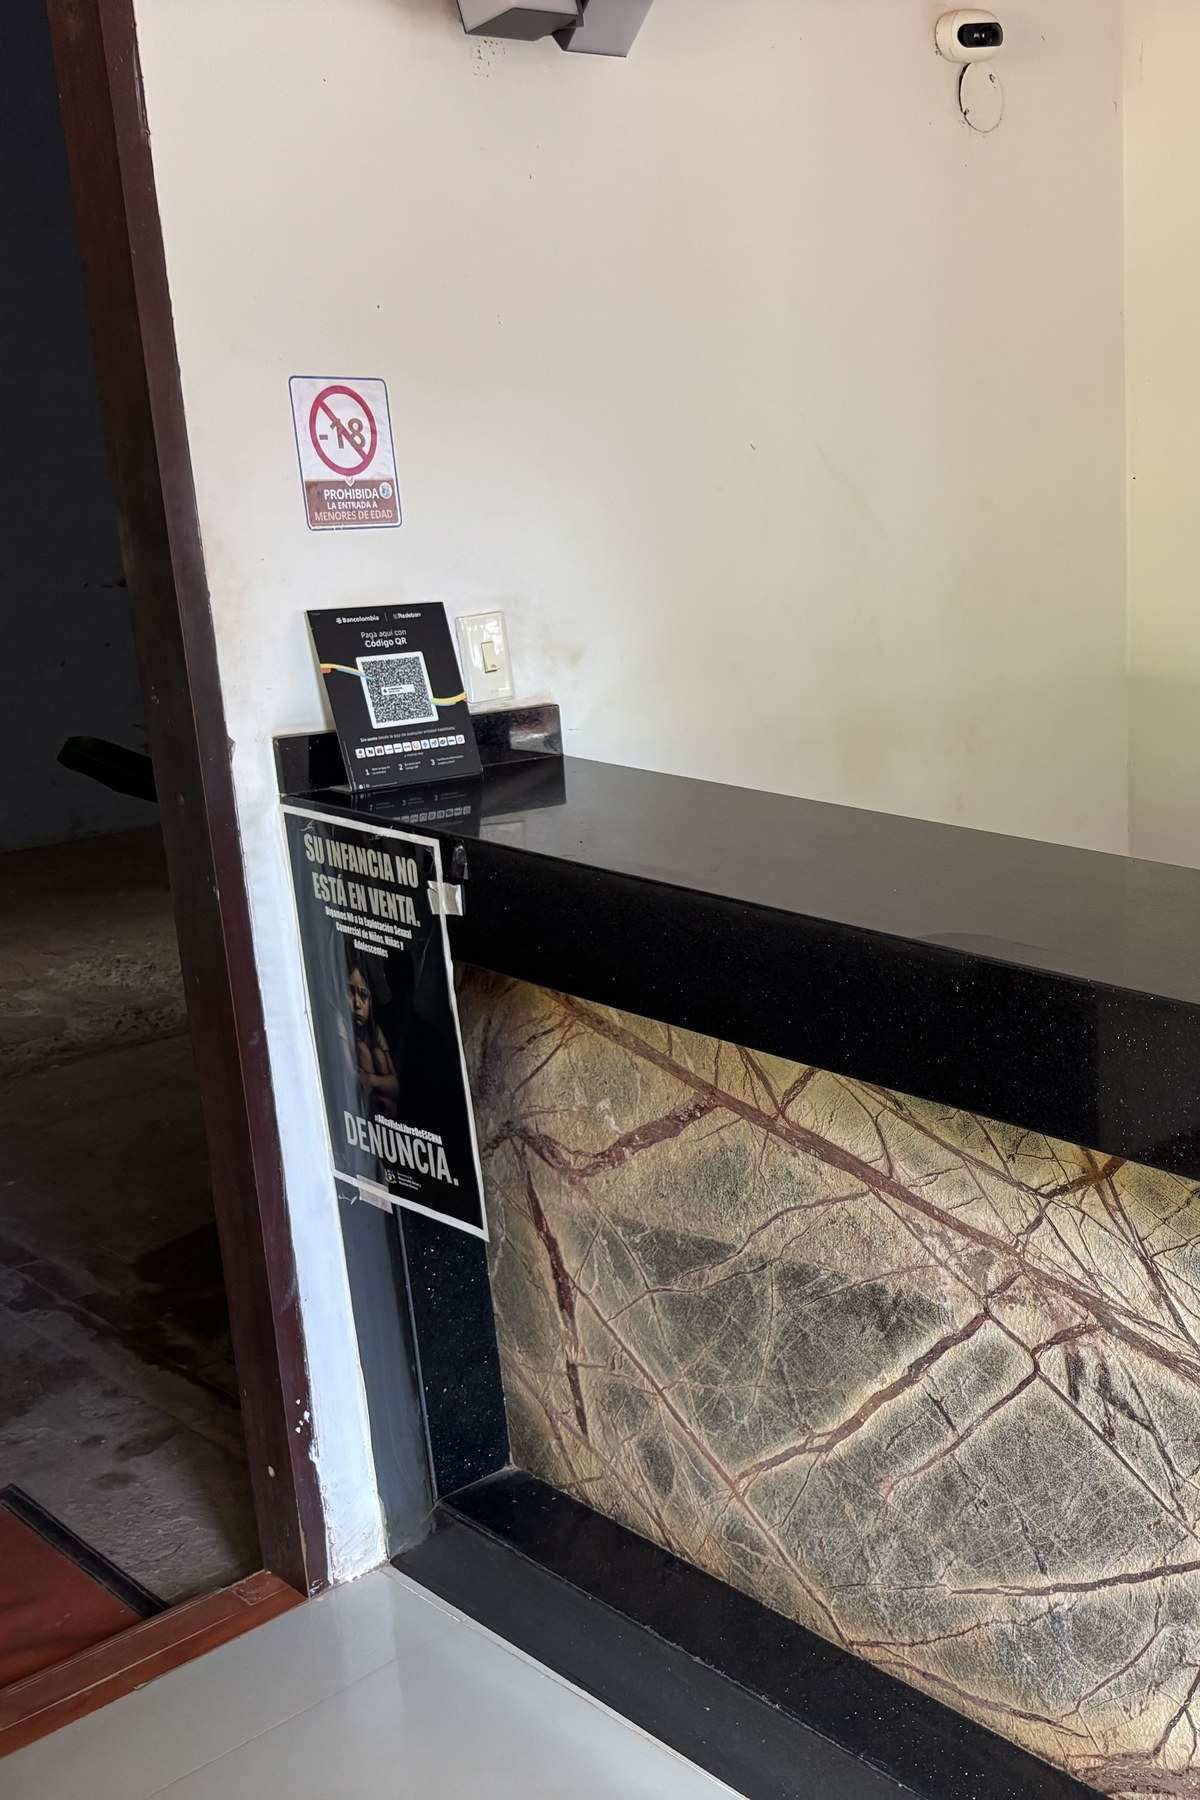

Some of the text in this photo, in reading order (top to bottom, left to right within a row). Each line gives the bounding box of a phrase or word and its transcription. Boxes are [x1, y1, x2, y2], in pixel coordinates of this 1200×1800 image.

[323, 488, 379, 500] PROHIBIDA
[327, 500, 378, 510] LA ENTRADA A
[314, 509, 393, 521] MENORES DE EDAD
[342, 614, 380, 623] Bancolombia
[361, 631, 378, 639] Paga
[365, 637, 407, 648] Código QR
[303, 833, 419, 888] SU INFANCIA NO
[312, 871, 421, 928] ESTÁ EN VENTA.
[354, 938, 389, 958] Adolescentes
[343, 1110, 459, 1187] DENUNCIA.
